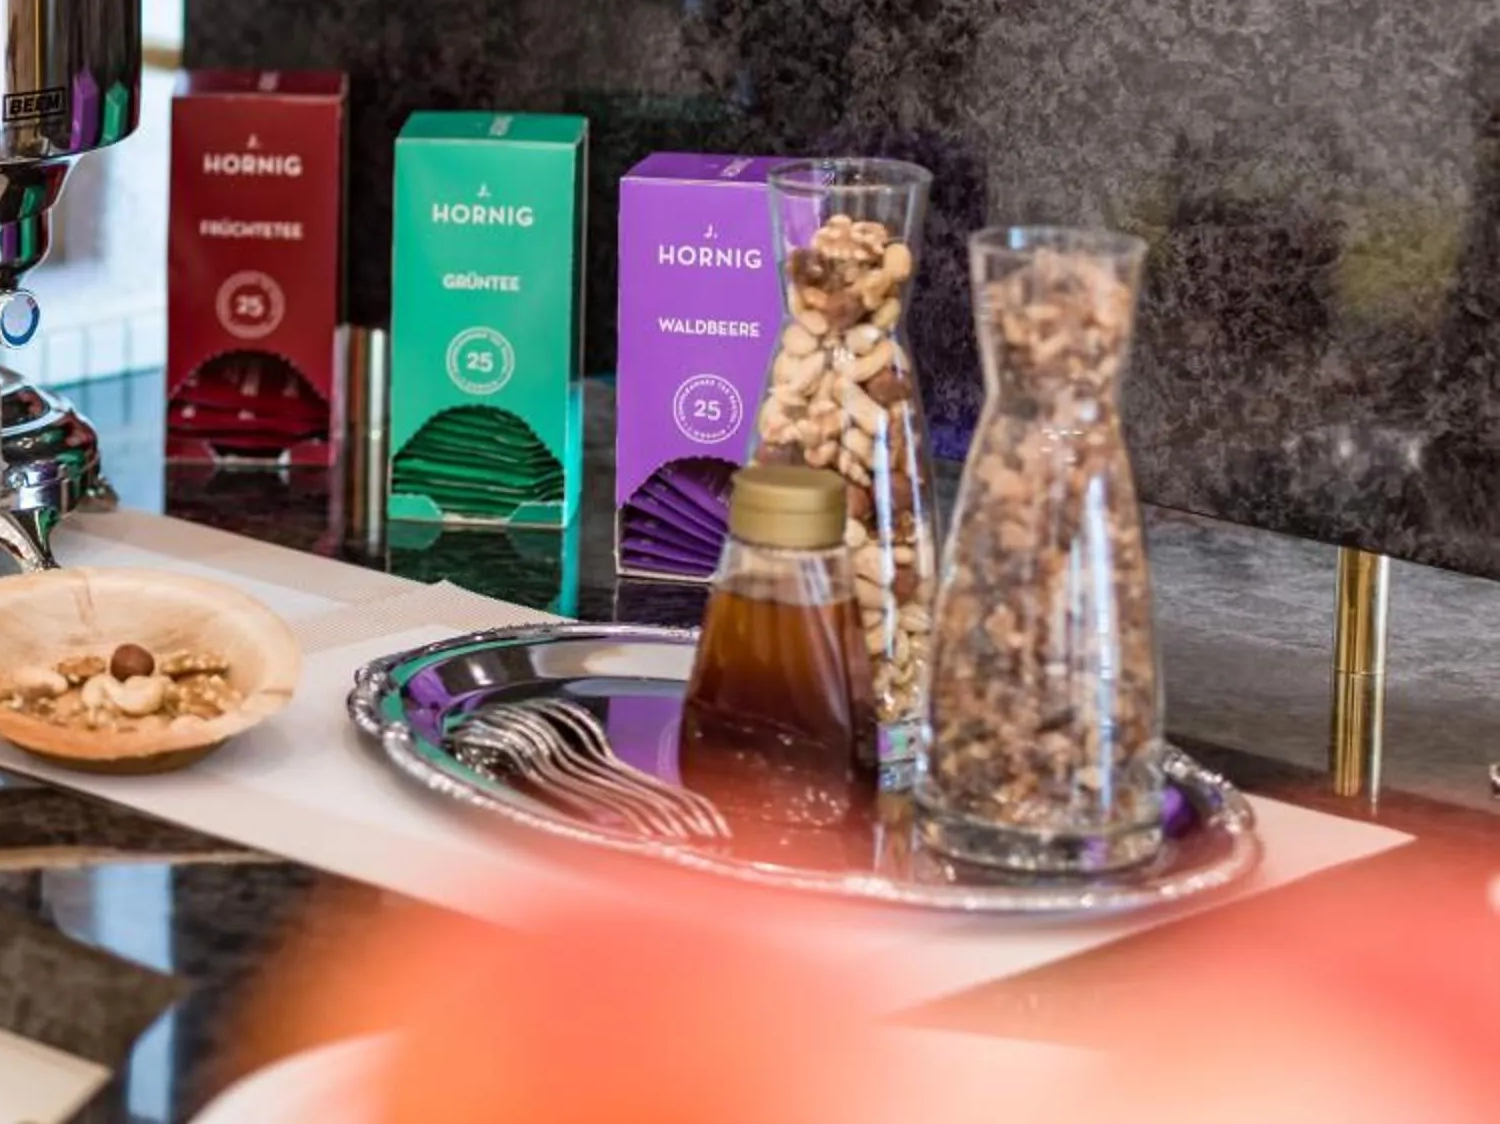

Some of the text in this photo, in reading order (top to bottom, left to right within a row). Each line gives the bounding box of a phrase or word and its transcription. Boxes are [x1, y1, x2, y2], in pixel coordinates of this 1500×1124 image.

[9, 93, 60, 116] BEEM
[202, 153, 303, 177] HORNIG
[432, 203, 534, 227] HORNIG
[703, 223, 718, 239] J.
[659, 244, 762, 269] HORNIG
[442, 271, 520, 292] GRÜNTEE
[235, 294, 264, 318] 25
[658, 316, 760, 338] WALDBEERE
[466, 351, 493, 373] 25
[693, 399, 721, 421] 25
